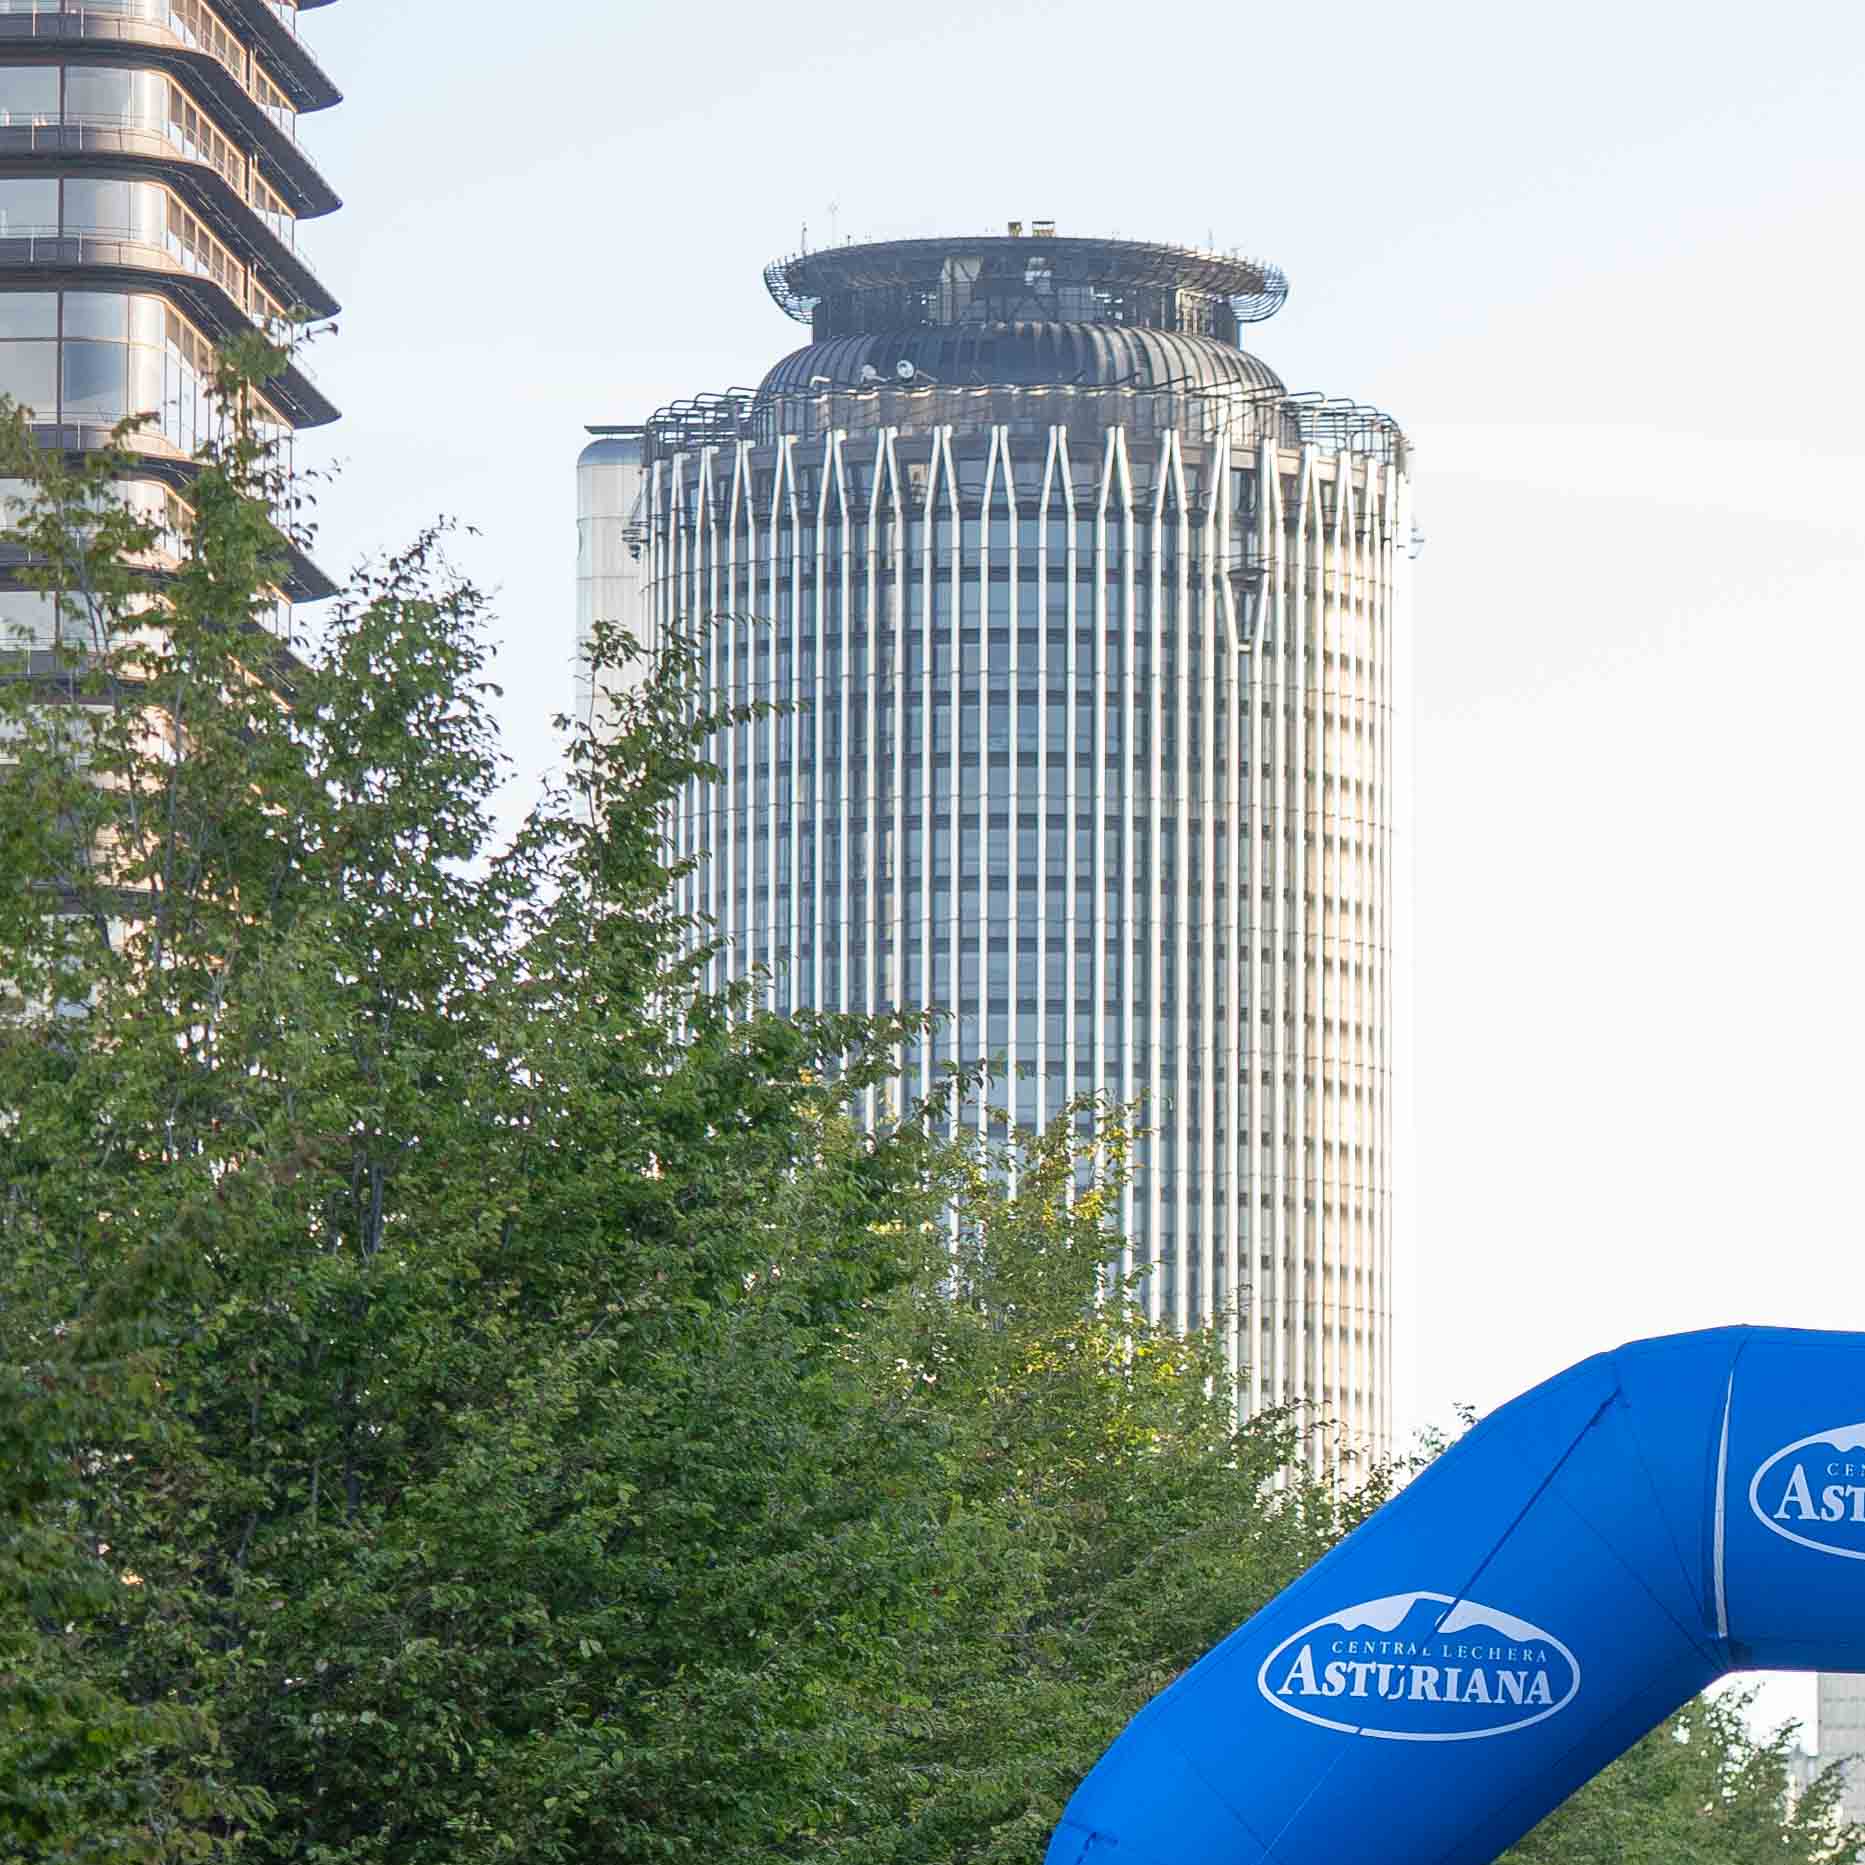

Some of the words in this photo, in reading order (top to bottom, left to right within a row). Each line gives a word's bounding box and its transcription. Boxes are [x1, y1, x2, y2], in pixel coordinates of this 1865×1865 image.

[1332, 1640, 1432, 1656] CENTRAL
[1443, 1645, 1547, 1663] LECHERA
[1277, 1644, 1554, 1705] ASTURIANA
